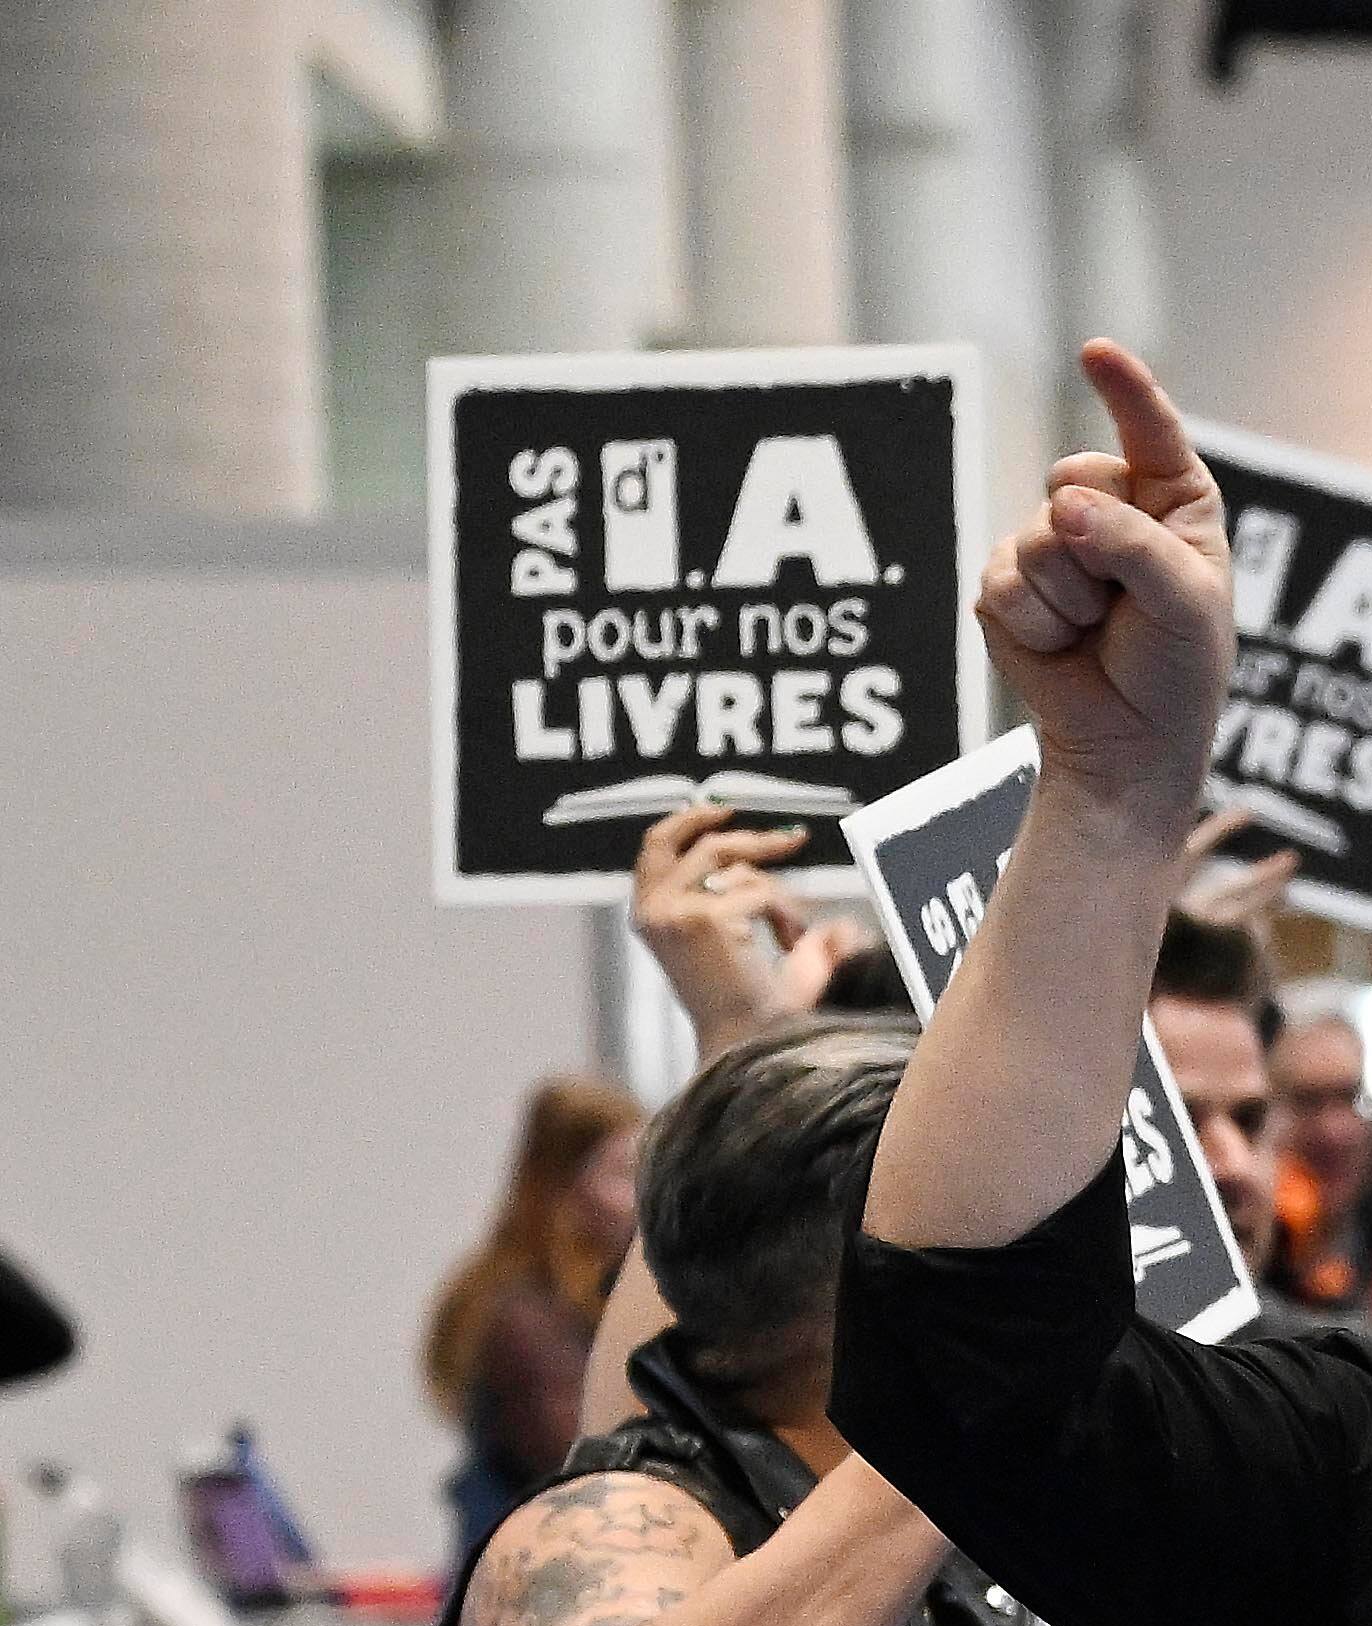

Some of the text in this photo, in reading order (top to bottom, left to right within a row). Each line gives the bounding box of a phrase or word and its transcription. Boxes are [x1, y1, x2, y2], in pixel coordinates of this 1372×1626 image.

[509, 445, 581, 596] PAS
[542, 599, 868, 678] pour nos
[511, 665, 904, 761] LIVRES
